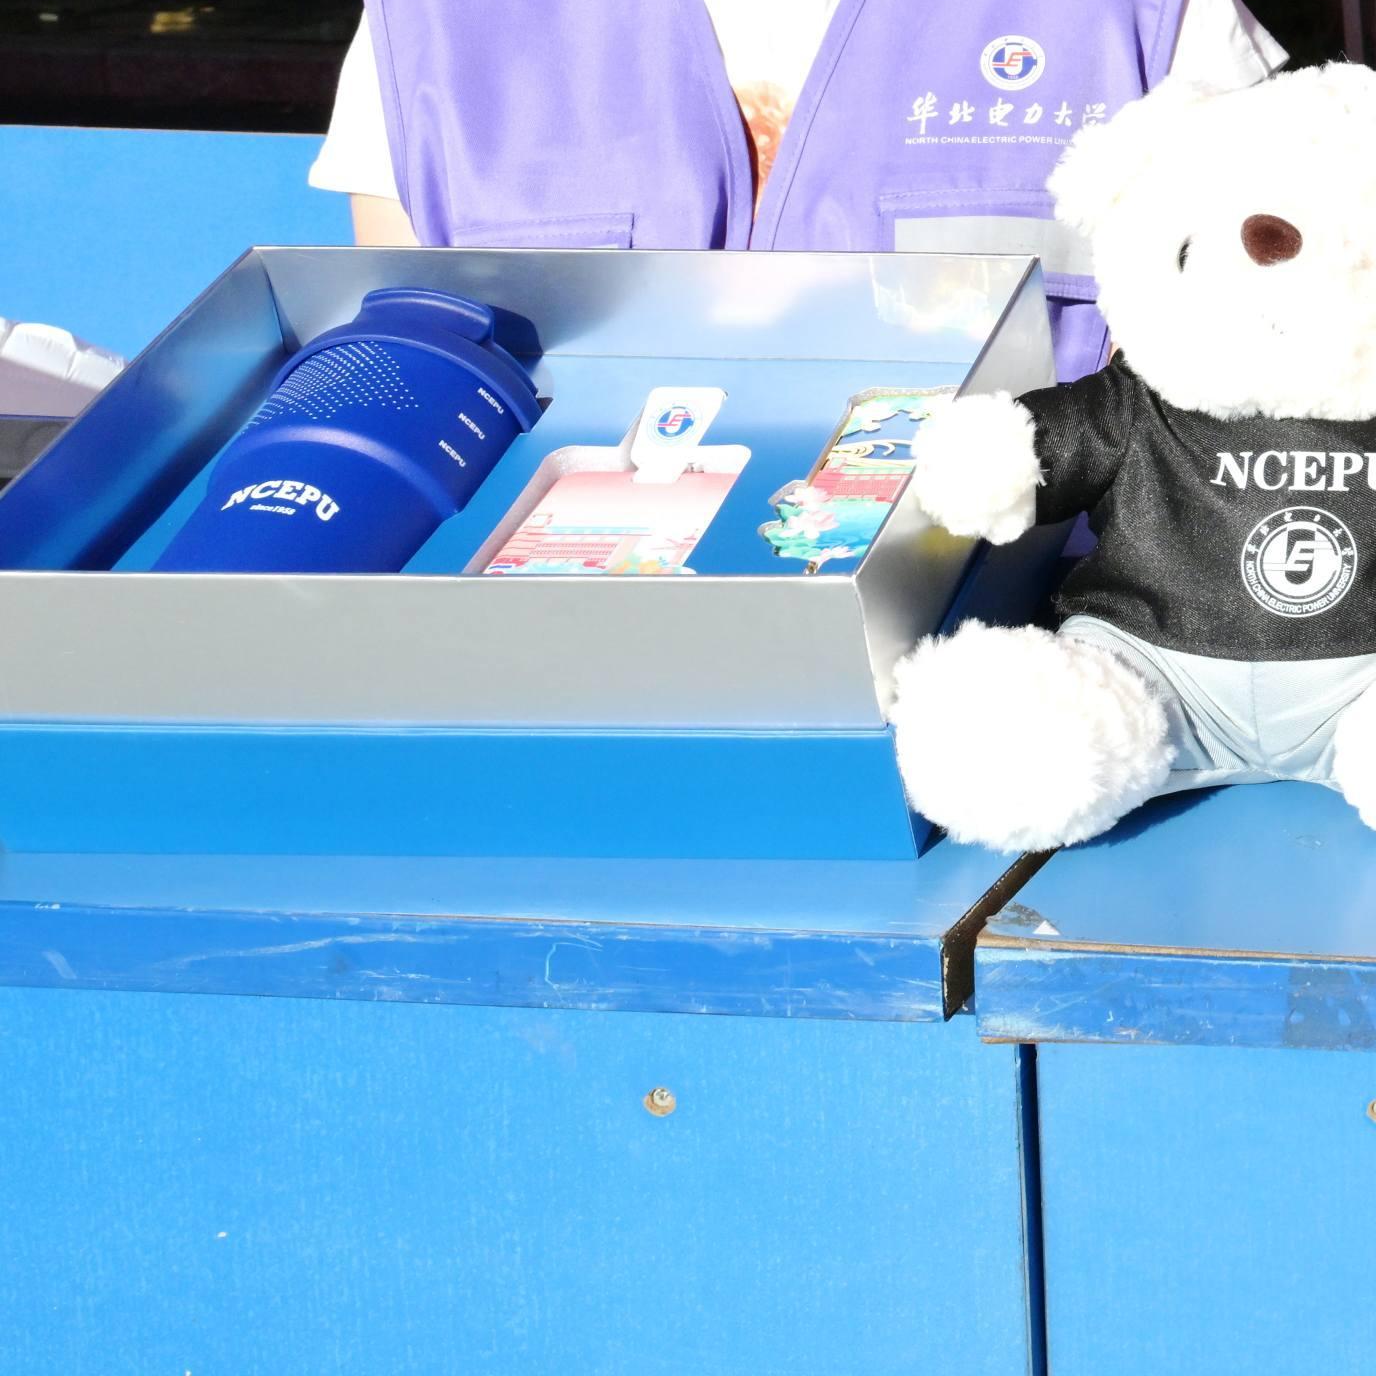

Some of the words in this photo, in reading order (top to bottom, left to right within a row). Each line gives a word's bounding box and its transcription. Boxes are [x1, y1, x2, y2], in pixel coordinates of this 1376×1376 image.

[905, 136, 938, 145] NORTH
[940, 136, 970, 145] CHINA
[971, 135, 1017, 144] ELECTRIC
[1018, 135, 1053, 144] POWER
[477, 387, 504, 415] NCEPU
[458, 412, 485, 440] NCEPU
[438, 440, 467, 467] NCEPU
[220, 480, 341, 521] NCEPU
[1267, 597, 1302, 614] ELECTRIC
[1302, 596, 1330, 613] POWER
